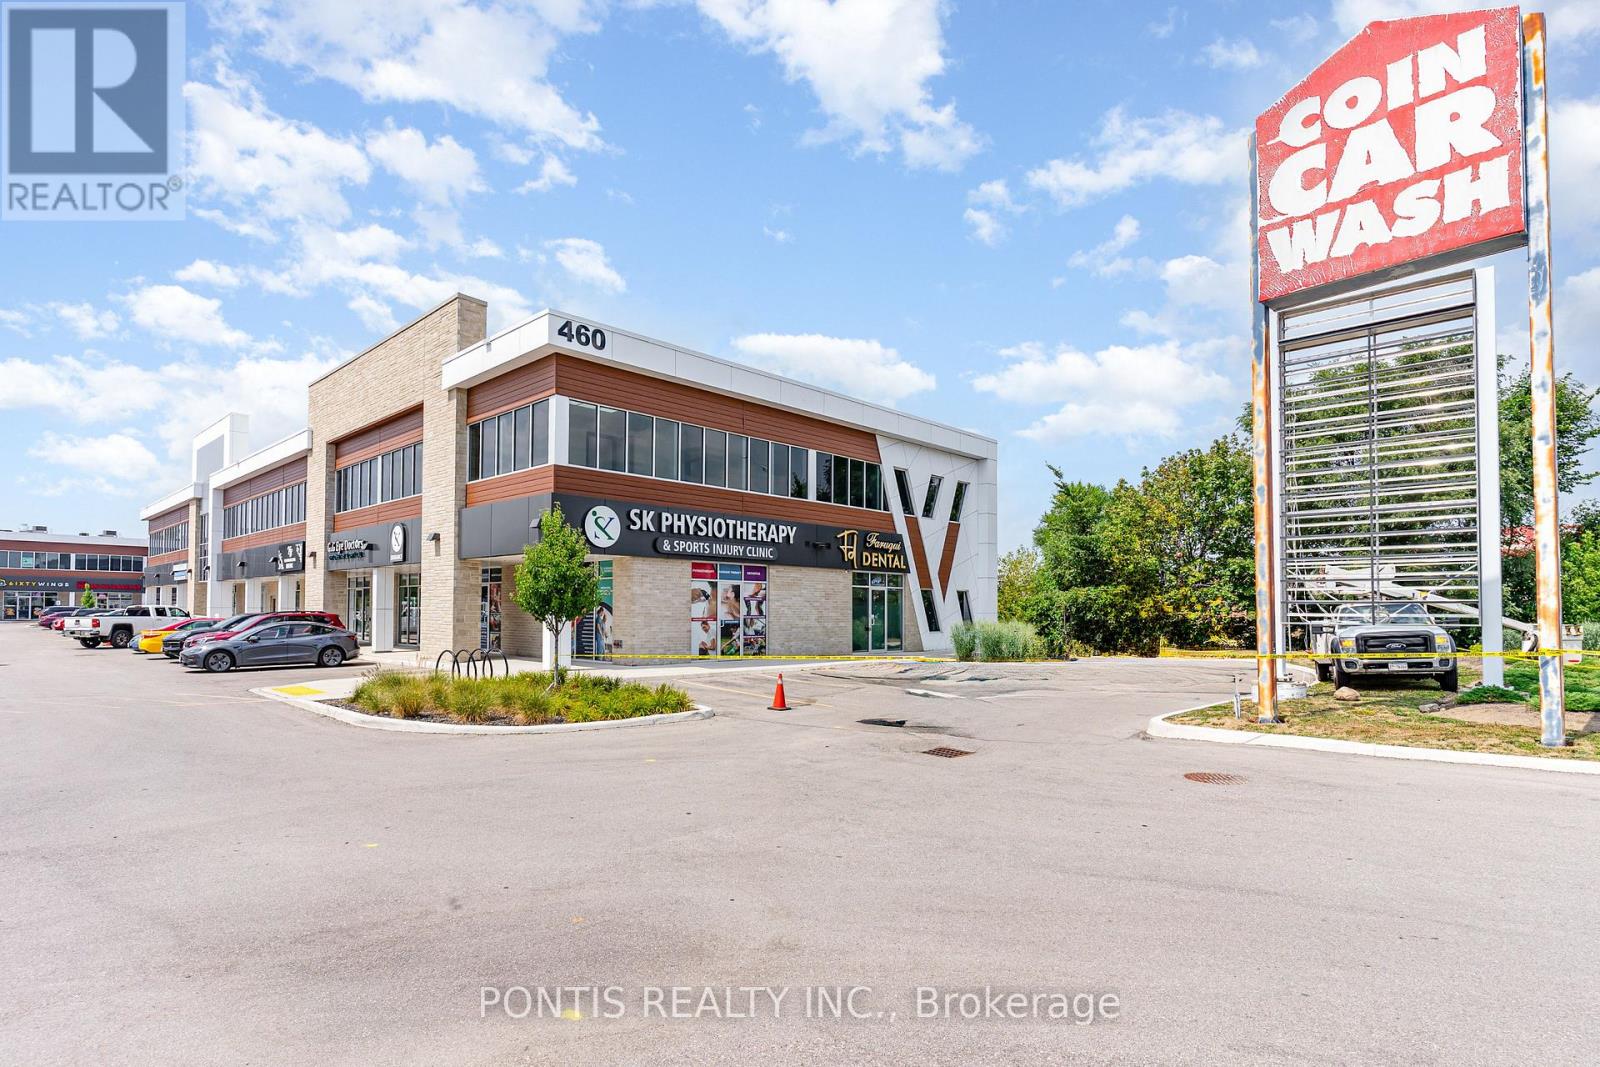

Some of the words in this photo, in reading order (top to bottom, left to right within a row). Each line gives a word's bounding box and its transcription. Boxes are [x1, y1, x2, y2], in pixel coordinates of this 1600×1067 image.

[1266, 24, 1487, 147] COIN
[1260, 85, 1503, 226] CAR
[1266, 151, 1516, 274] WASH
[557, 320, 606, 351] 460
[629, 508, 656, 532] SK
[661, 512, 797, 545] PHYSIOTHERAPY
[345, 539, 364, 551] Doctors
[662, 539, 671, 551] &
[673, 540, 710, 555] SPORTS
[712, 543, 745, 557] INJURY
[746, 546, 774, 559] CLINIC
[862, 551, 906, 569] DENTAL
